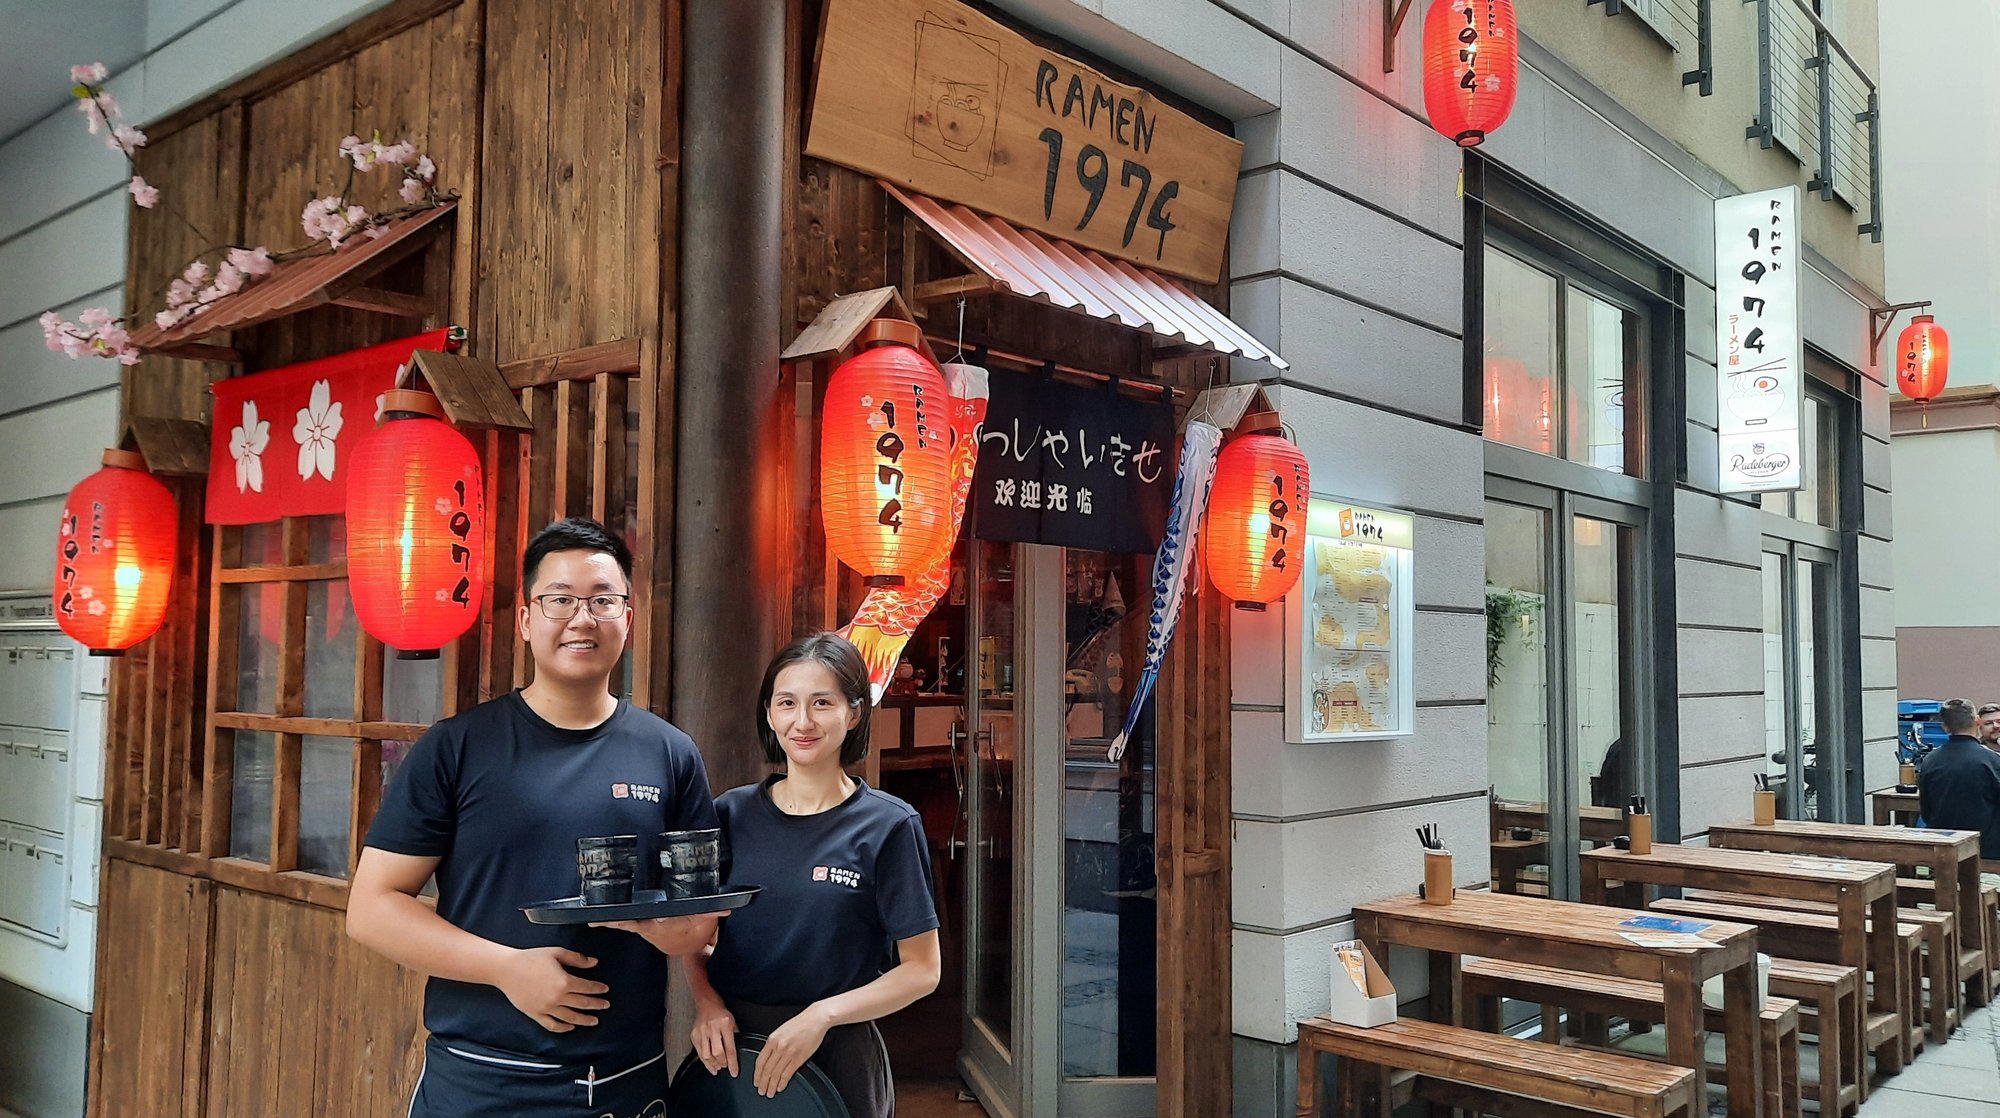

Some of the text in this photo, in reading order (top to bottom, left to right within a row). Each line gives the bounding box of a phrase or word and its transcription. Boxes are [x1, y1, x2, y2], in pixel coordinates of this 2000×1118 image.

[1458, 7, 1478, 93] 1974
[1036, 59, 1156, 153] RAMEN
[1037, 127, 1180, 260] 1974
[1770, 199, 1782, 272] RAMEN
[1741, 227, 1767, 355] 1974
[1906, 341, 1917, 384] 1974
[912, 384, 928, 449] RAMEN
[876, 400, 905, 534] 1974
[994, 478, 1093, 515] 欢迎光临
[1730, 454, 1787, 473] Radeberger
[449, 479, 471, 610] 1974
[1269, 475, 1289, 573] 1974
[1356, 522, 1383, 543] 1974
[61, 515, 79, 617] 1974
[630, 784, 660, 795] RAMEN
[630, 790, 660, 803] 1974
[829, 873, 858, 888] 1974
[830, 867, 861, 880] RAMEN
